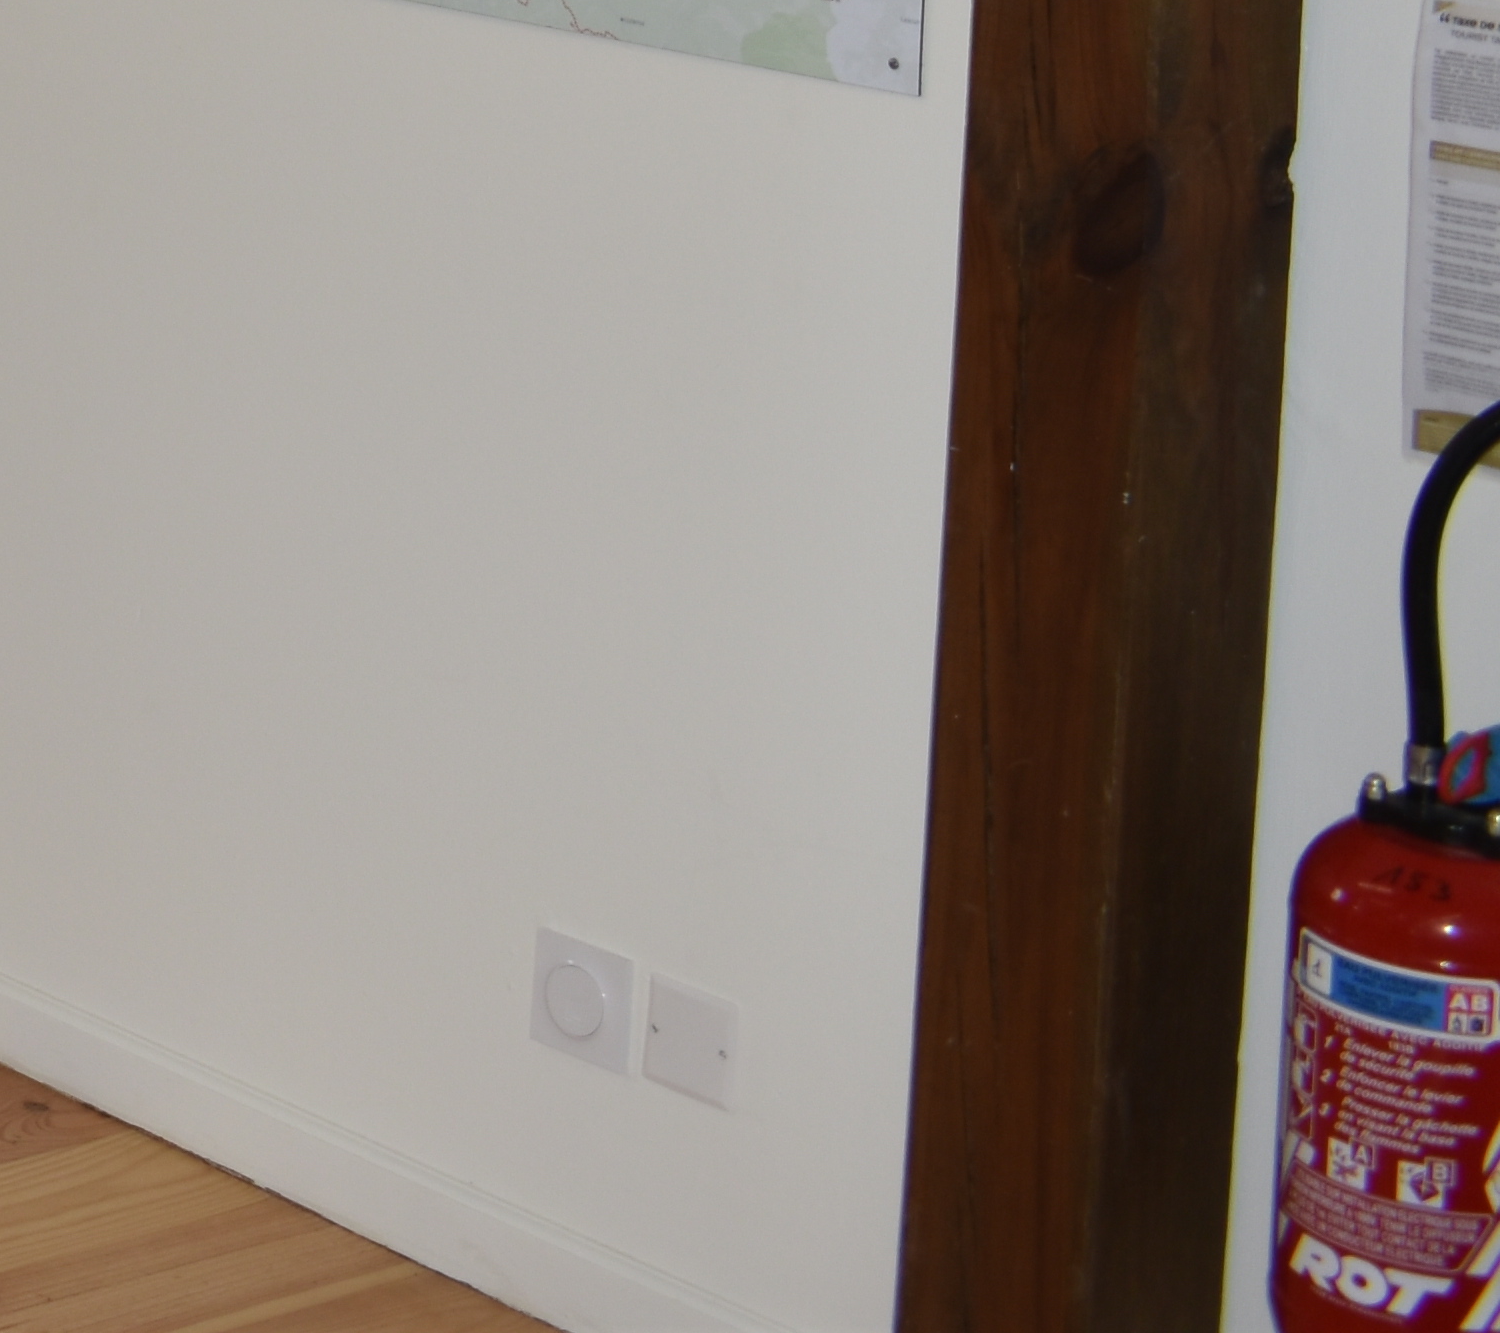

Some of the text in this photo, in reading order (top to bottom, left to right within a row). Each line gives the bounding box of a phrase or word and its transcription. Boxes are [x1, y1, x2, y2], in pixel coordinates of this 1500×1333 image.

[1340, 1051, 1356, 1063] de
[1336, 1079, 1433, 1113] de commande
[1421, 1089, 1464, 1105] levier
[1418, 1133, 1456, 1147] base
[1289, 1233, 1455, 1317] ROT
